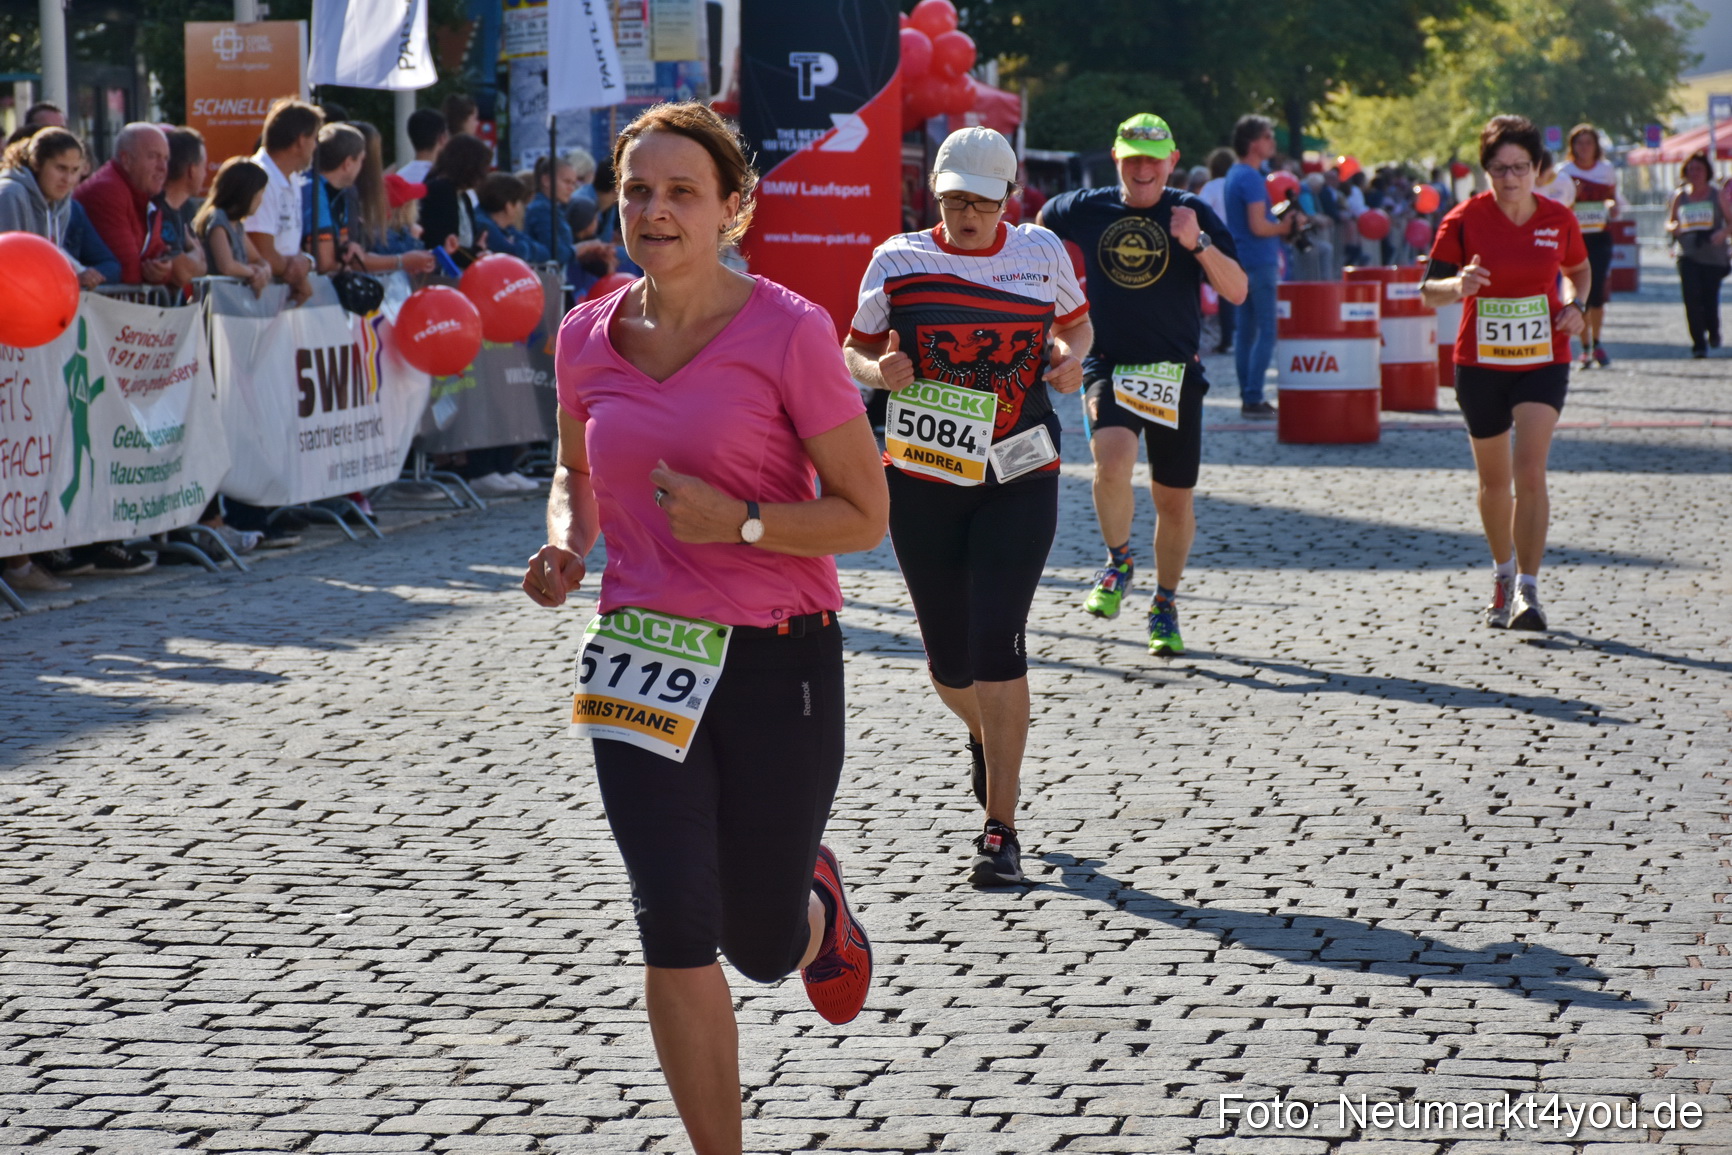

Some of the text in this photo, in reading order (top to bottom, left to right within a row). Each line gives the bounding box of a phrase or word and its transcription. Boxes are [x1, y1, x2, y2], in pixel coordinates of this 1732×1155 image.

[191, 98, 282, 116] SCHNELLE
[777, 129, 827, 140] THE NEXT
[762, 181, 871, 199] BMW Laufsport
[992, 273, 1042, 283] NEUMARKT
[1484, 300, 1543, 316] BOCK
[1485, 320, 1543, 342] 5112
[1493, 346, 1537, 356] RENATE
[900, 382, 985, 416] BOCK
[897, 408, 977, 454] 5084
[903, 447, 964, 475] ANDREA
[579, 642, 697, 702] 5119
[802, 680, 812, 717] Reebok
[576, 699, 679, 736] CHRISTIANE
